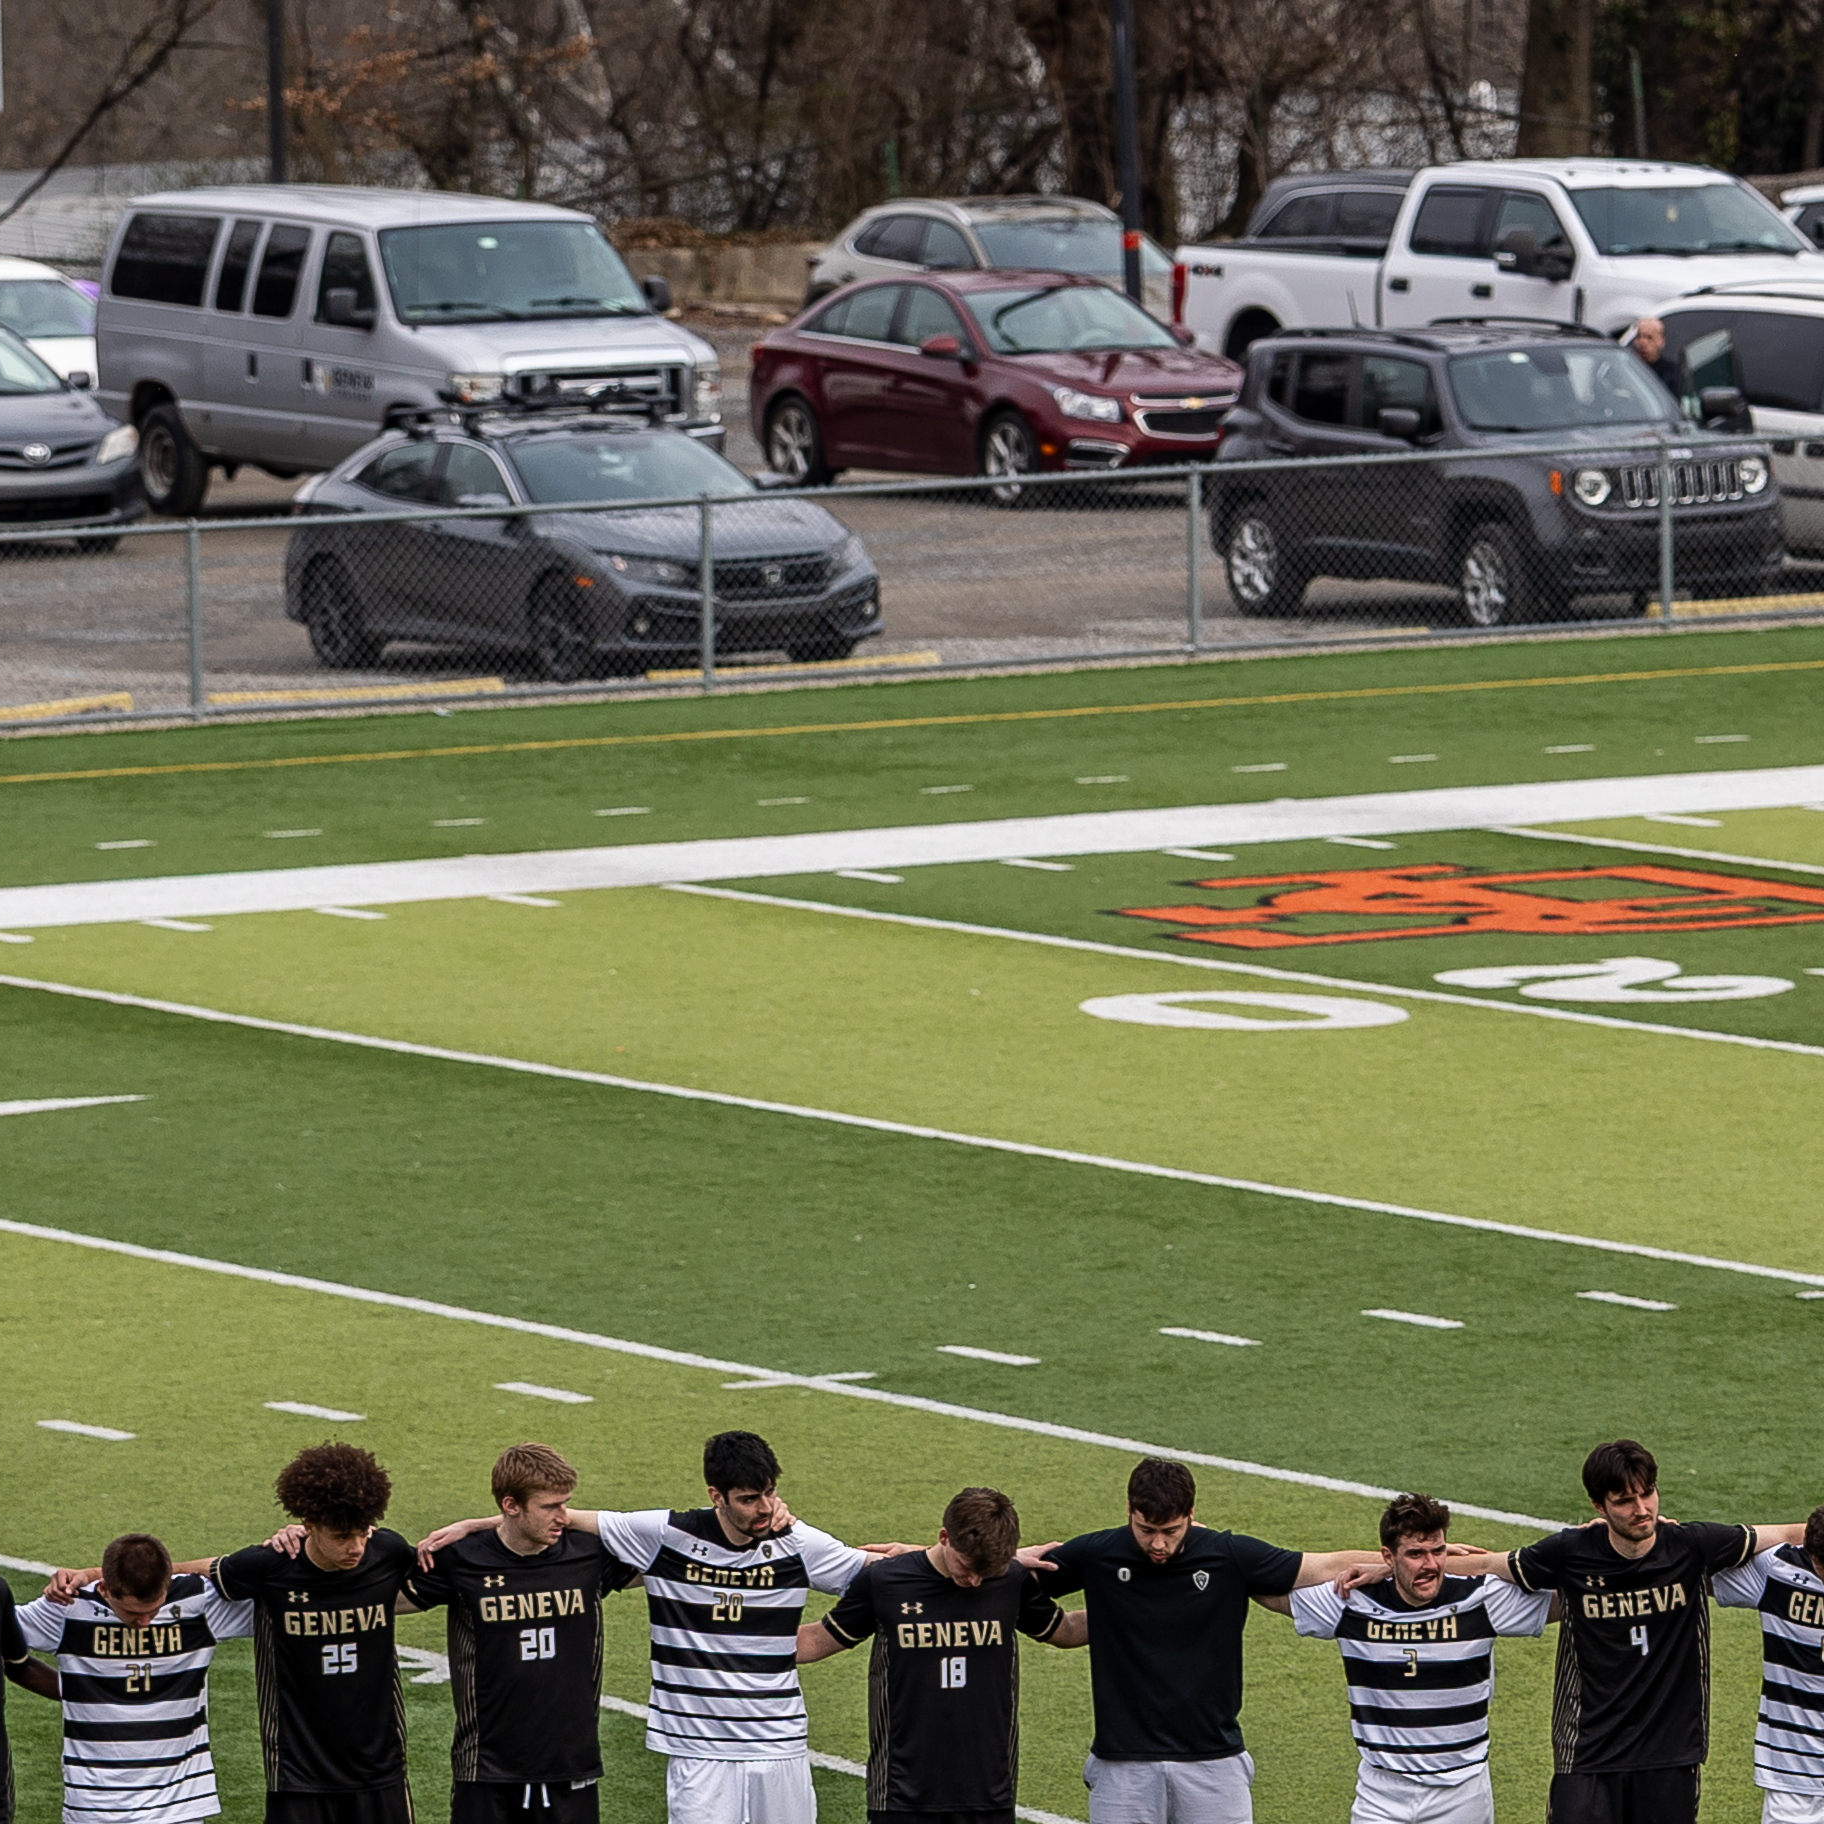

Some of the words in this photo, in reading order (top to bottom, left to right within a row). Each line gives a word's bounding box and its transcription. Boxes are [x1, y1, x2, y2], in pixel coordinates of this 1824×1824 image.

[686, 1563, 775, 1586] GENEVA
[479, 1588, 585, 1623] GENEVA
[712, 1591, 744, 1622] 20
[1582, 1582, 1687, 1620] GENEVA
[284, 1604, 387, 1637] GENEVA
[897, 1620, 1003, 1649] GENEVA
[1366, 1615, 1458, 1641] GENEVA
[93, 1624, 182, 1657] GENEVA
[520, 1627, 556, 1662] 20
[1629, 1626, 1649, 1657] 4
[321, 1643, 358, 1675] 25
[940, 1656, 967, 1689] 18
[1402, 1649, 1418, 1677] 3
[125, 1663, 152, 1694] 21
